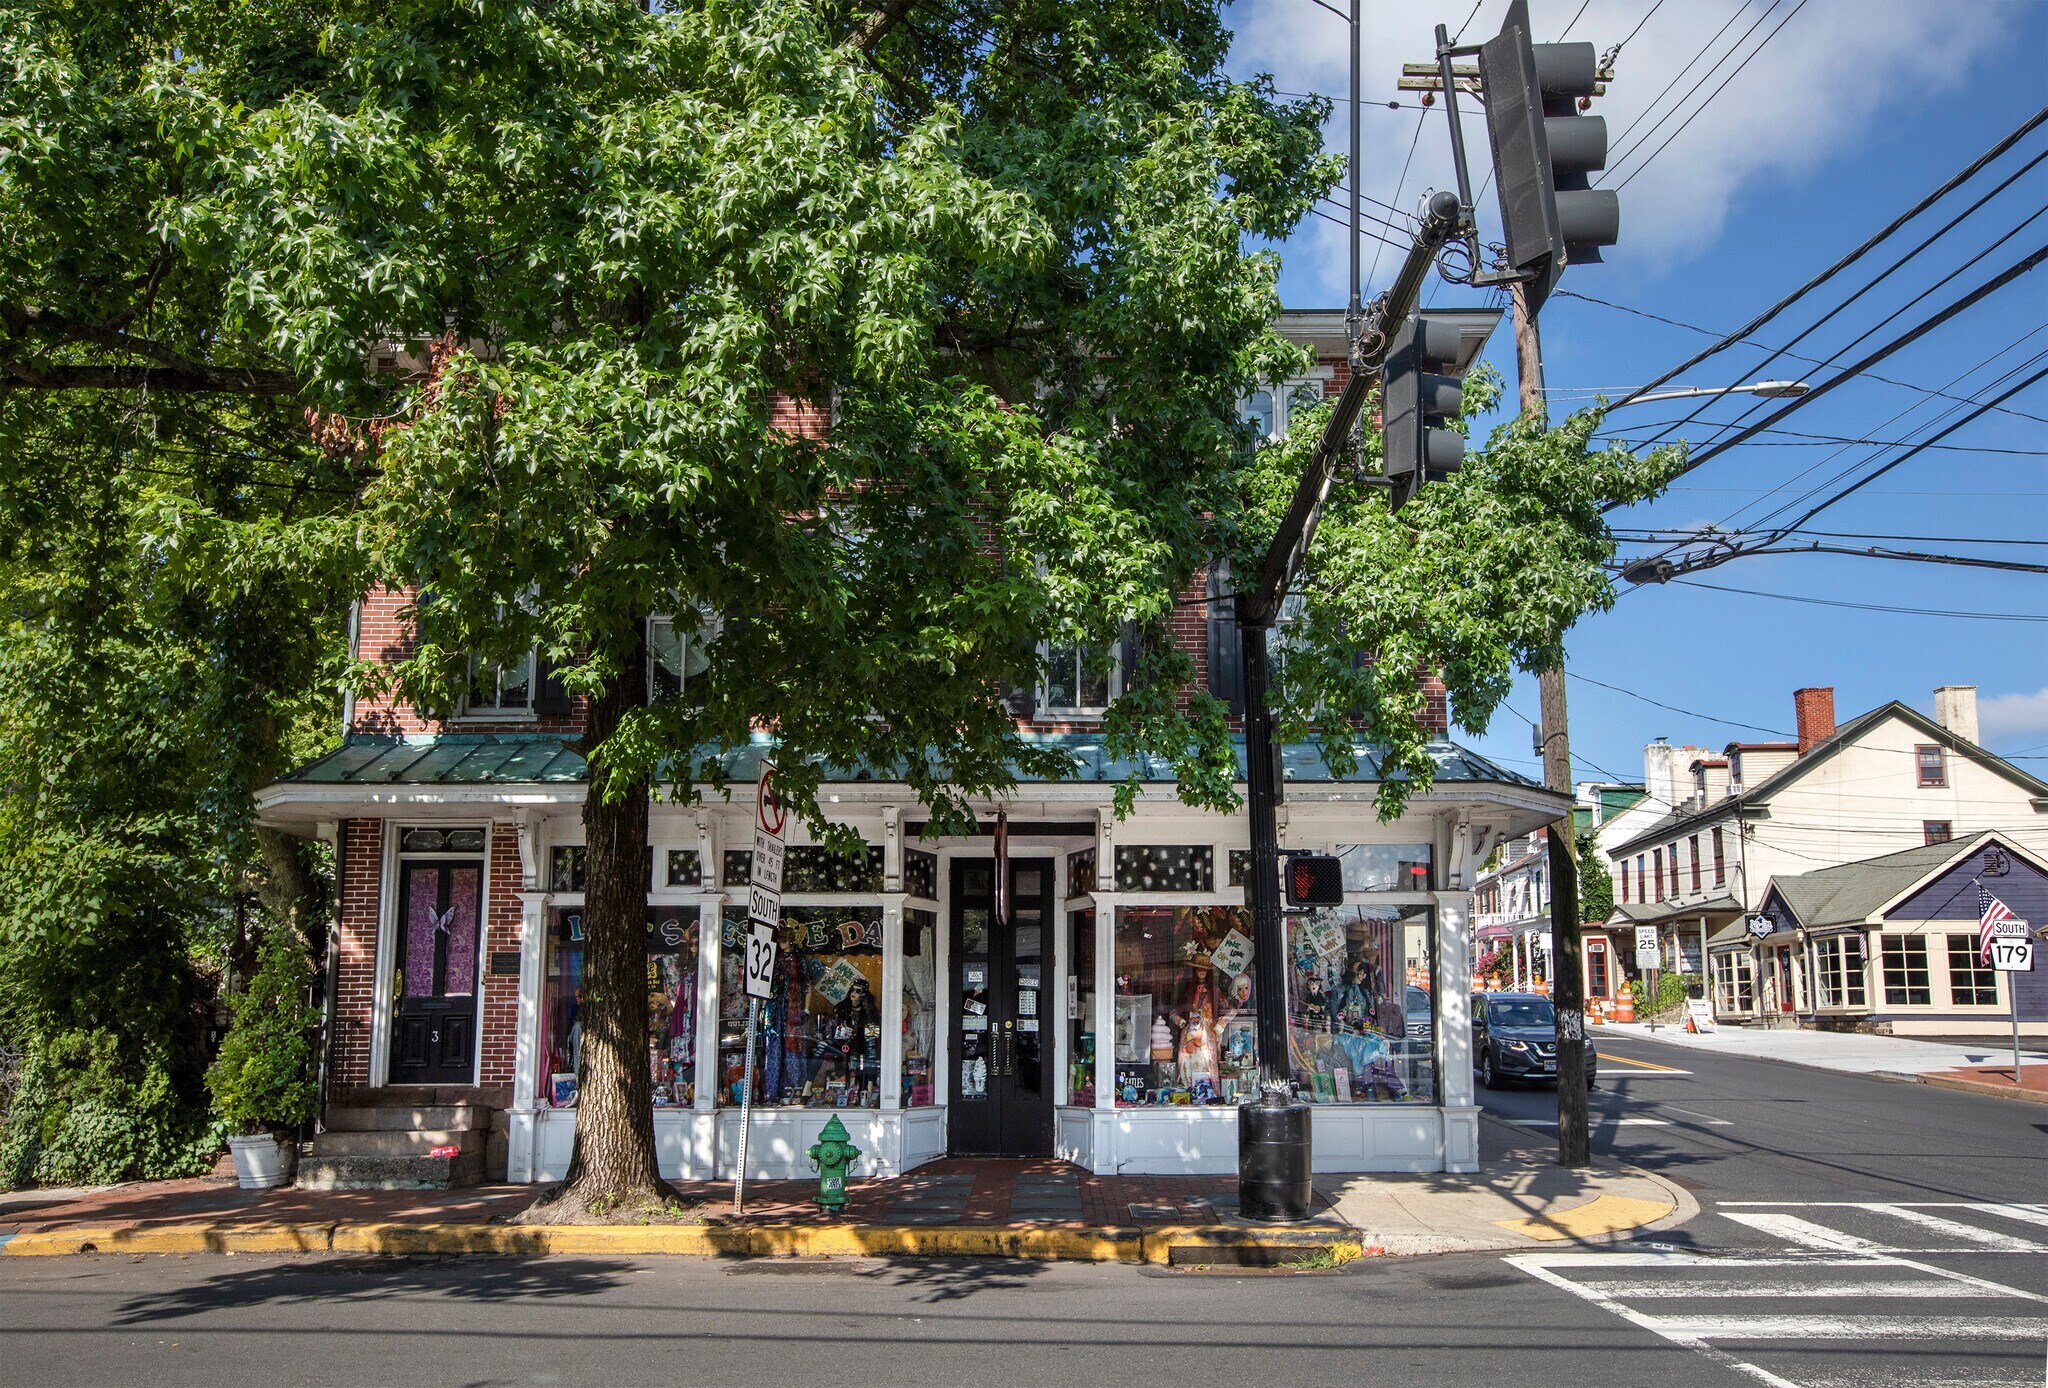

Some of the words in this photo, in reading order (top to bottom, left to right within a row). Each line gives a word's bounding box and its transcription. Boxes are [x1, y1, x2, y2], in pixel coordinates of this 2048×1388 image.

[752, 890, 778, 921] SOUTH
[1995, 922, 2026, 934] SOUTH
[1639, 940, 1656, 950] 25
[749, 938, 772, 983] 32
[1996, 945, 2028, 964] 179
[431, 1030, 439, 1042] 3
